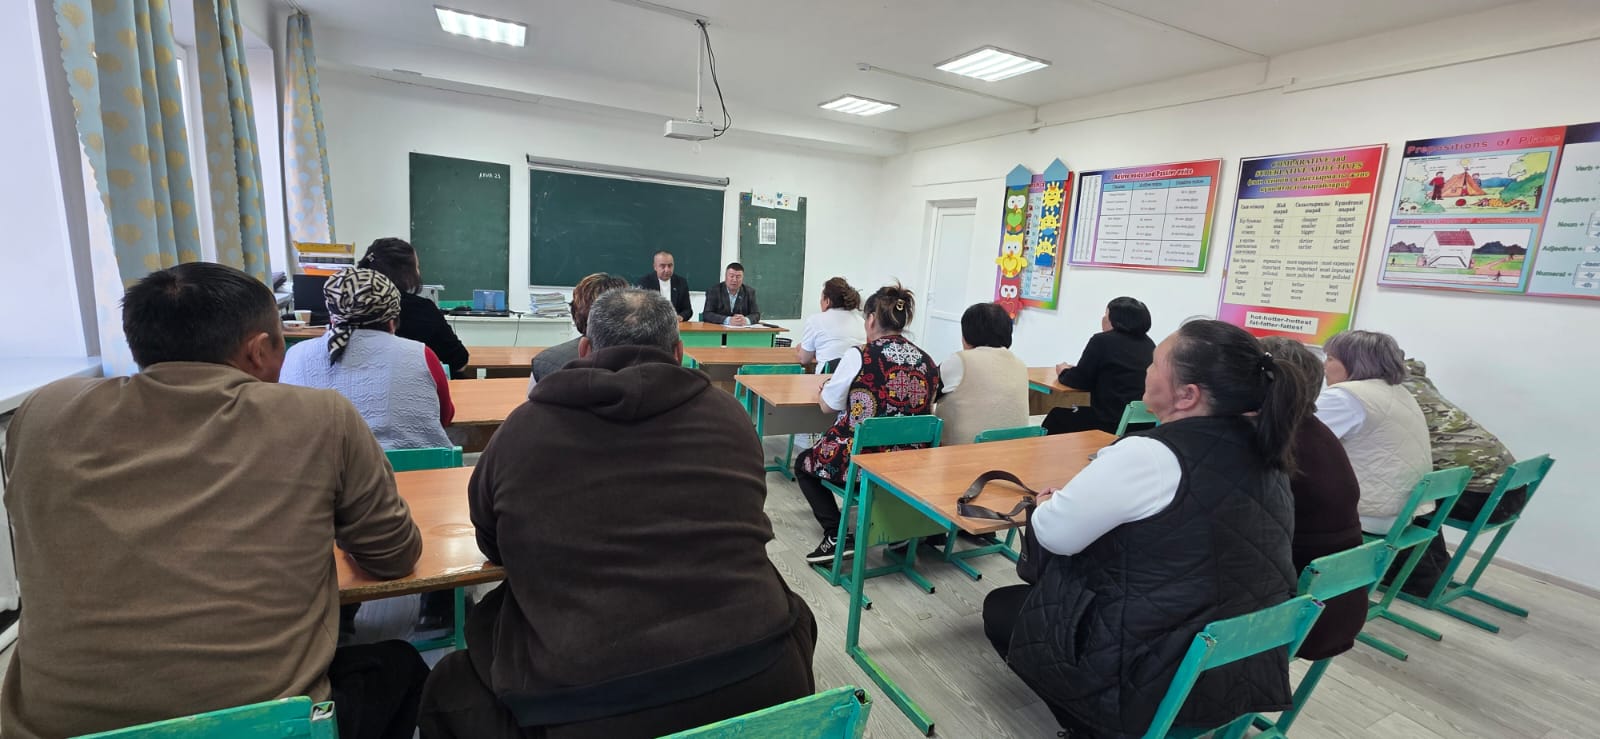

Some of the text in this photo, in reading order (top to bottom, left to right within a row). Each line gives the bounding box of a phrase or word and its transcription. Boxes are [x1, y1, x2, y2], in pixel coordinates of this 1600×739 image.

[1407, 141, 1488, 154] Prepositions
[1496, 138, 1511, 147] of
[1554, 196, 1590, 204] Adjective
[1542, 245, 1577, 253] Adjective
